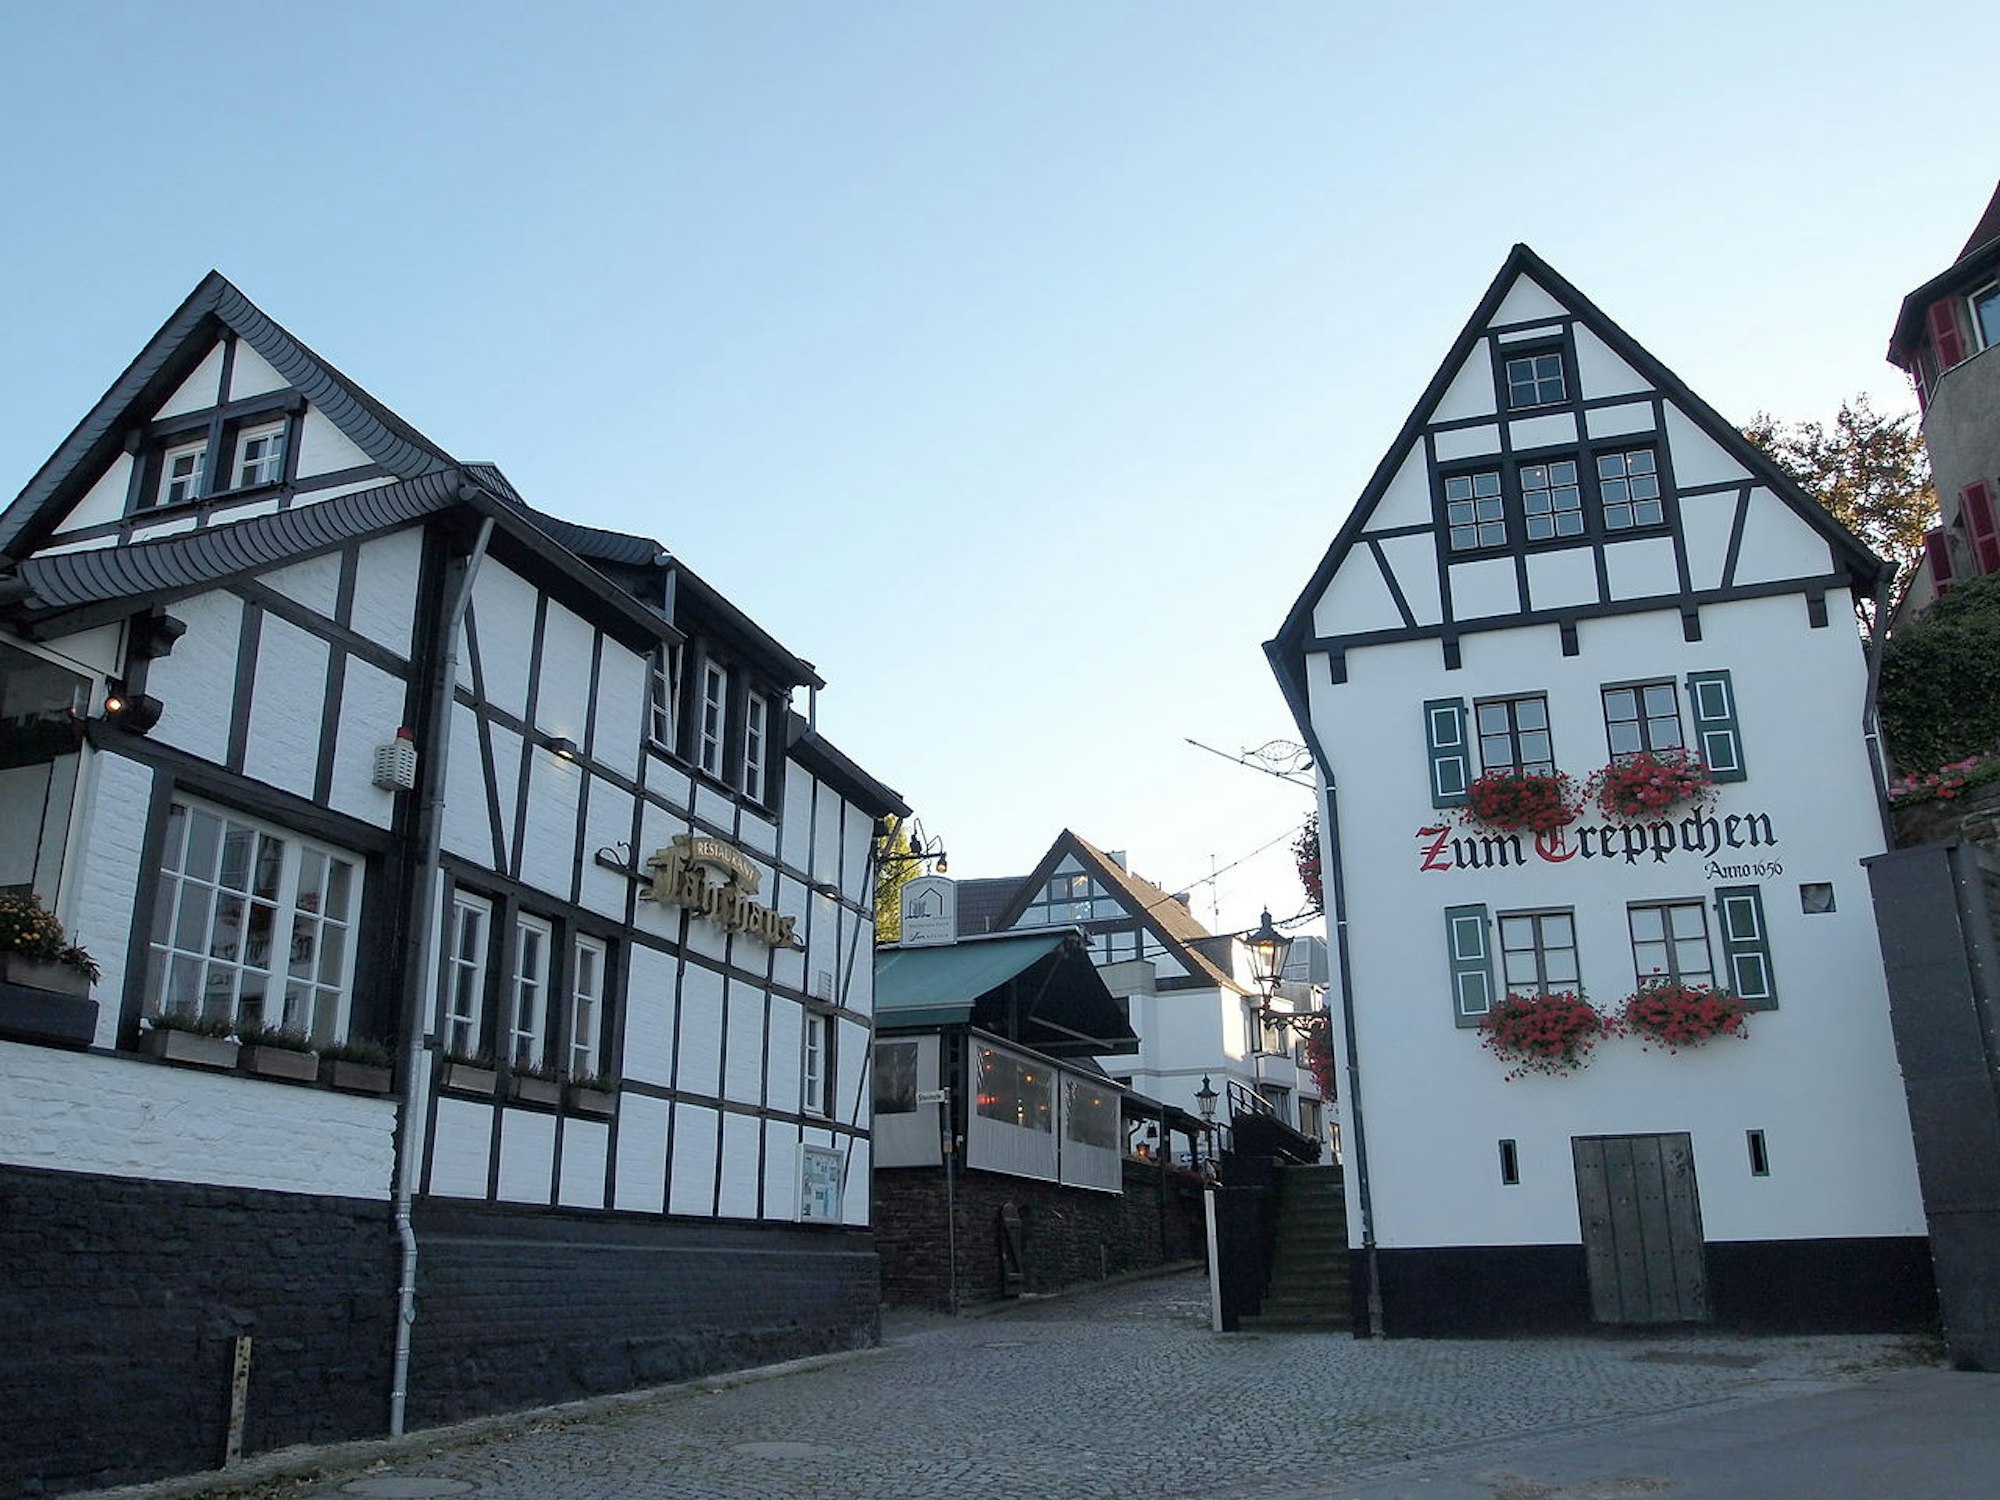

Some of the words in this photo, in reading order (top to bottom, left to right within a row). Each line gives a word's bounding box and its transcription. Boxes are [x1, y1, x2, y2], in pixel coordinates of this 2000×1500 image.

[1415, 826, 1526, 872] Zum
[1534, 804, 1778, 866] Treppchen
[697, 841, 755, 881] RESTAURANT
[1704, 860, 1751, 880] Anno
[1753, 856, 1784, 881] 1656
